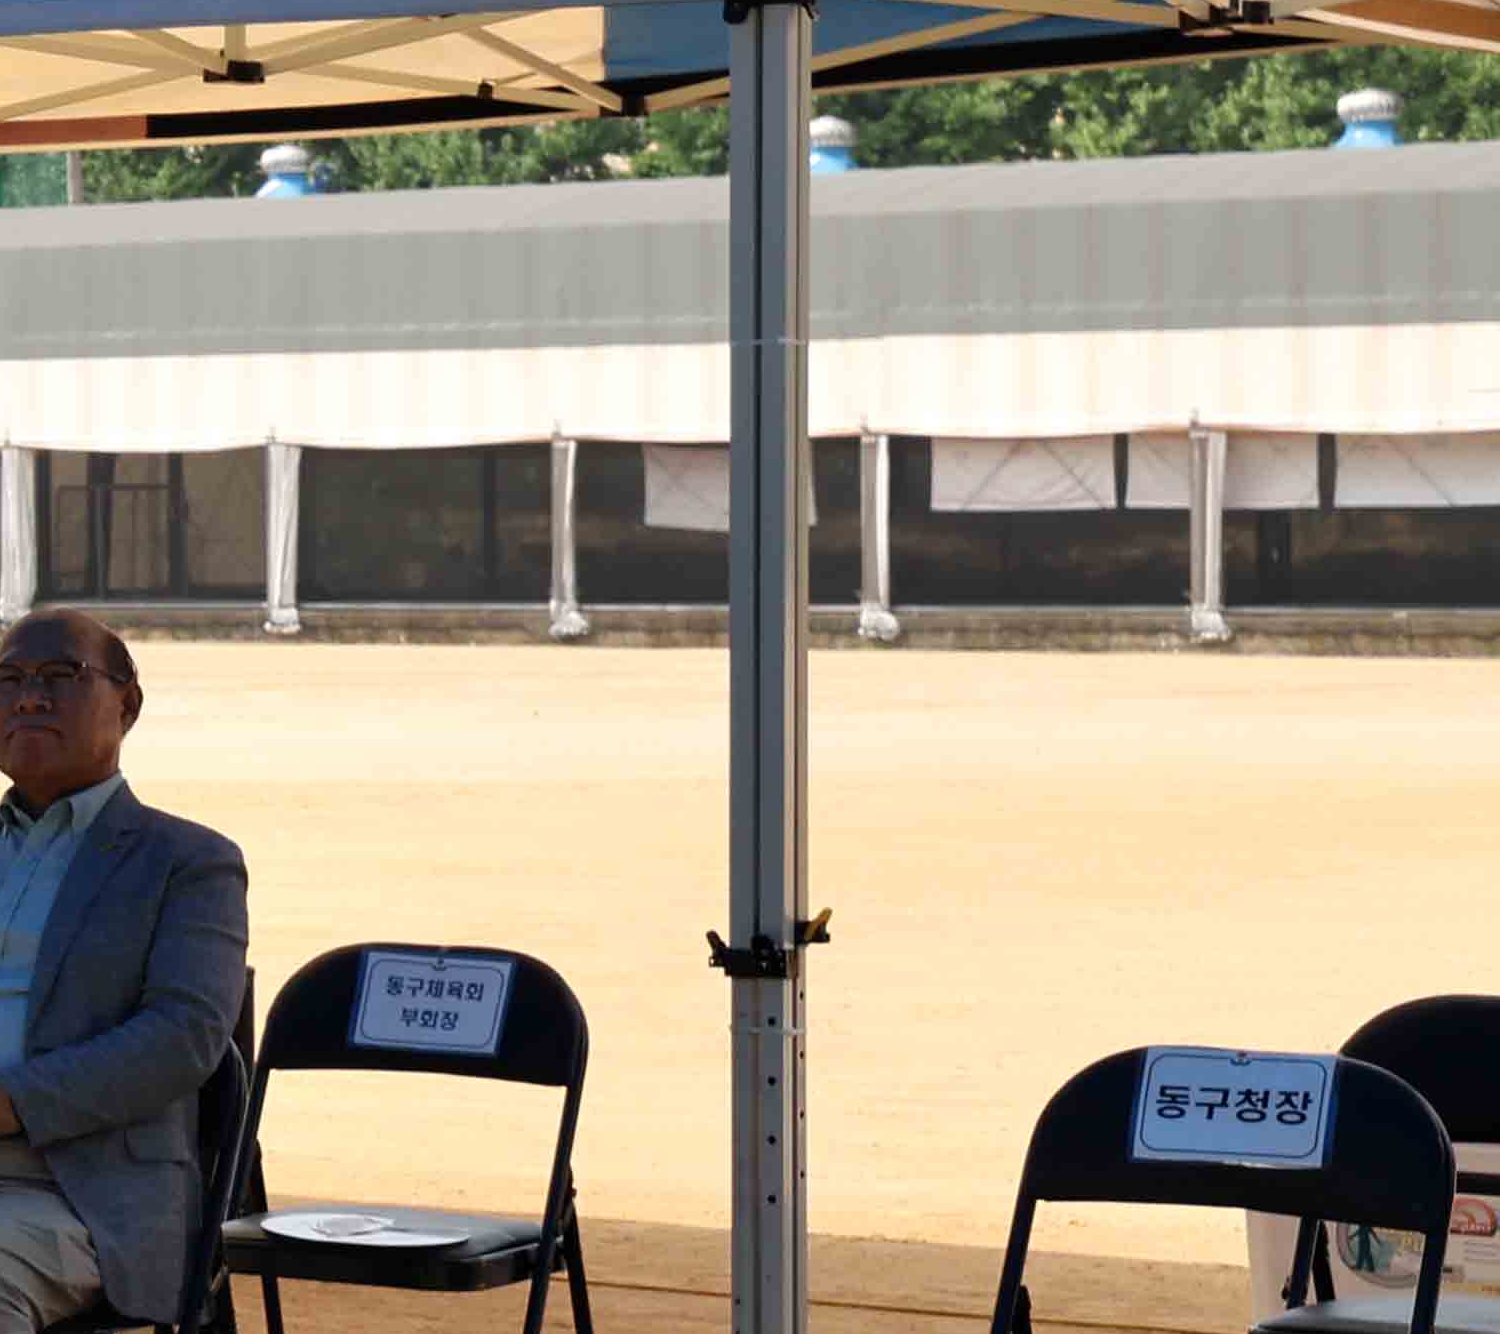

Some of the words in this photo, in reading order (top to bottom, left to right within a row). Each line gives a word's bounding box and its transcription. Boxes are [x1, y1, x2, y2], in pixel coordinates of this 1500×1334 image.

[386, 974, 485, 1002] 동구체육회
[401, 1007, 460, 1032] 부회장
[1155, 1084, 1313, 1126] 동구청장
